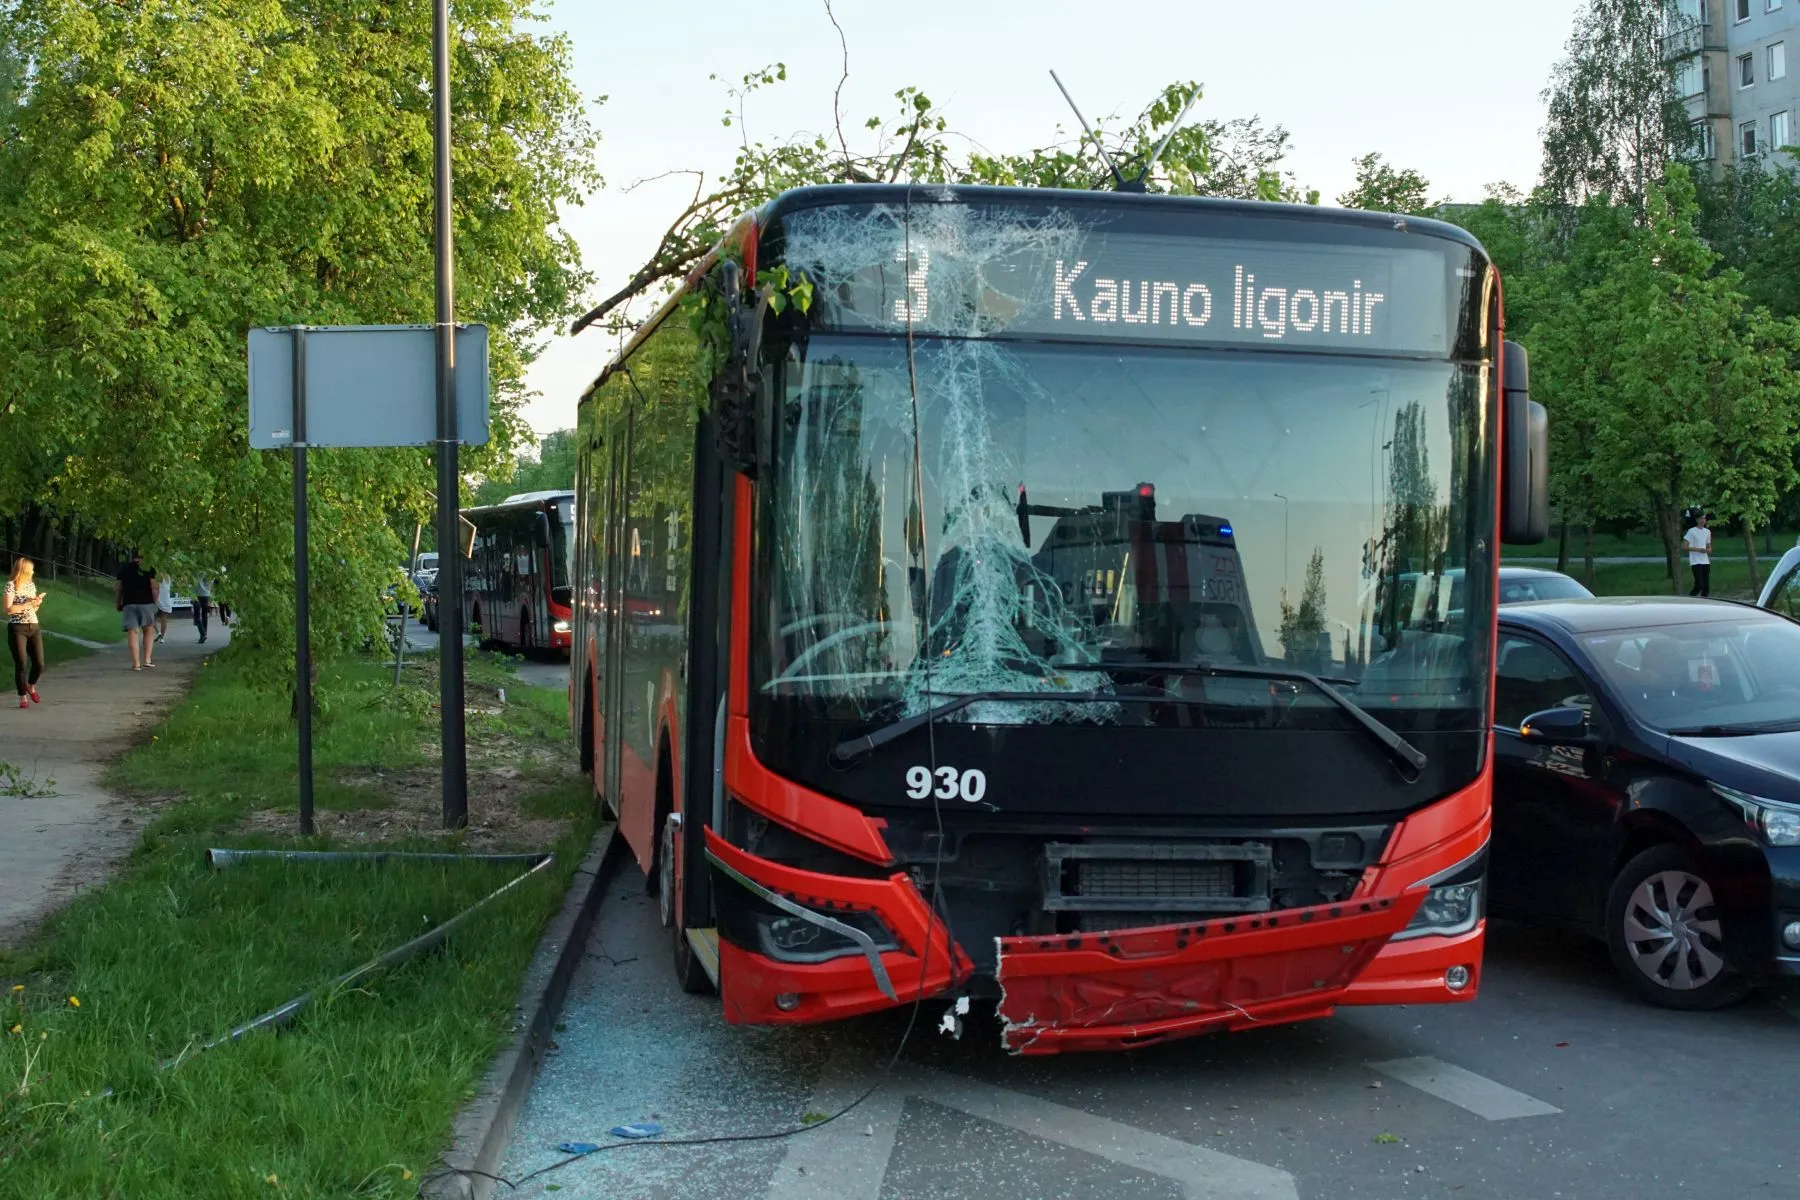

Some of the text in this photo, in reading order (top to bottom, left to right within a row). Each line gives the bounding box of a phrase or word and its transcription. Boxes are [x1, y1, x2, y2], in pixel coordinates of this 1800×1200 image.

[894, 240, 1384, 338] 3 Kauno ligonir
[905, 765, 986, 802] 930
